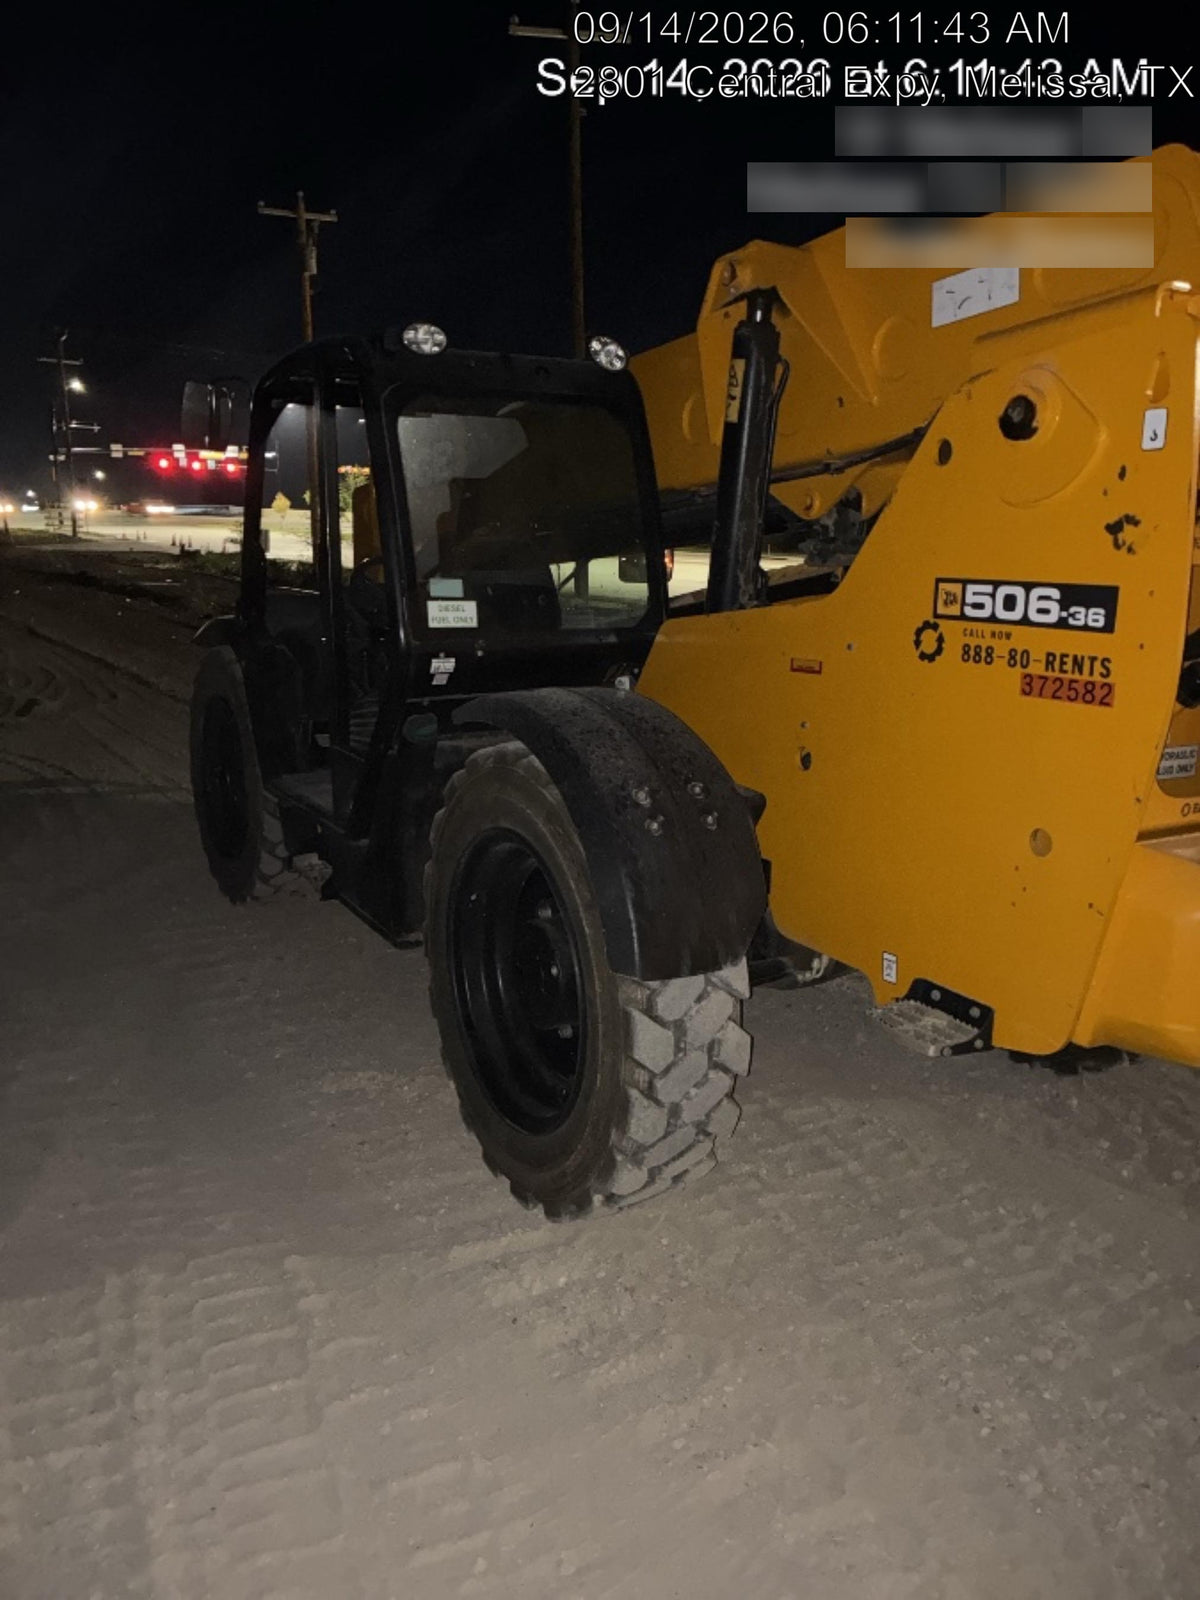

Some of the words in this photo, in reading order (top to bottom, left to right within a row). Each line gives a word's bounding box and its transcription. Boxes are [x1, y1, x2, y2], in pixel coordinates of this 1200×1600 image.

[438, 604, 466, 612] DIESEL
[431, 616, 451, 624] FUEL
[453, 616, 474, 624] ONLY
[963, 628, 986, 639] CALL
[990, 630, 1013, 641] NOW
[961, 643, 1112, 679] 888-80-RENTS
[1021, 673, 1113, 707] 372582
